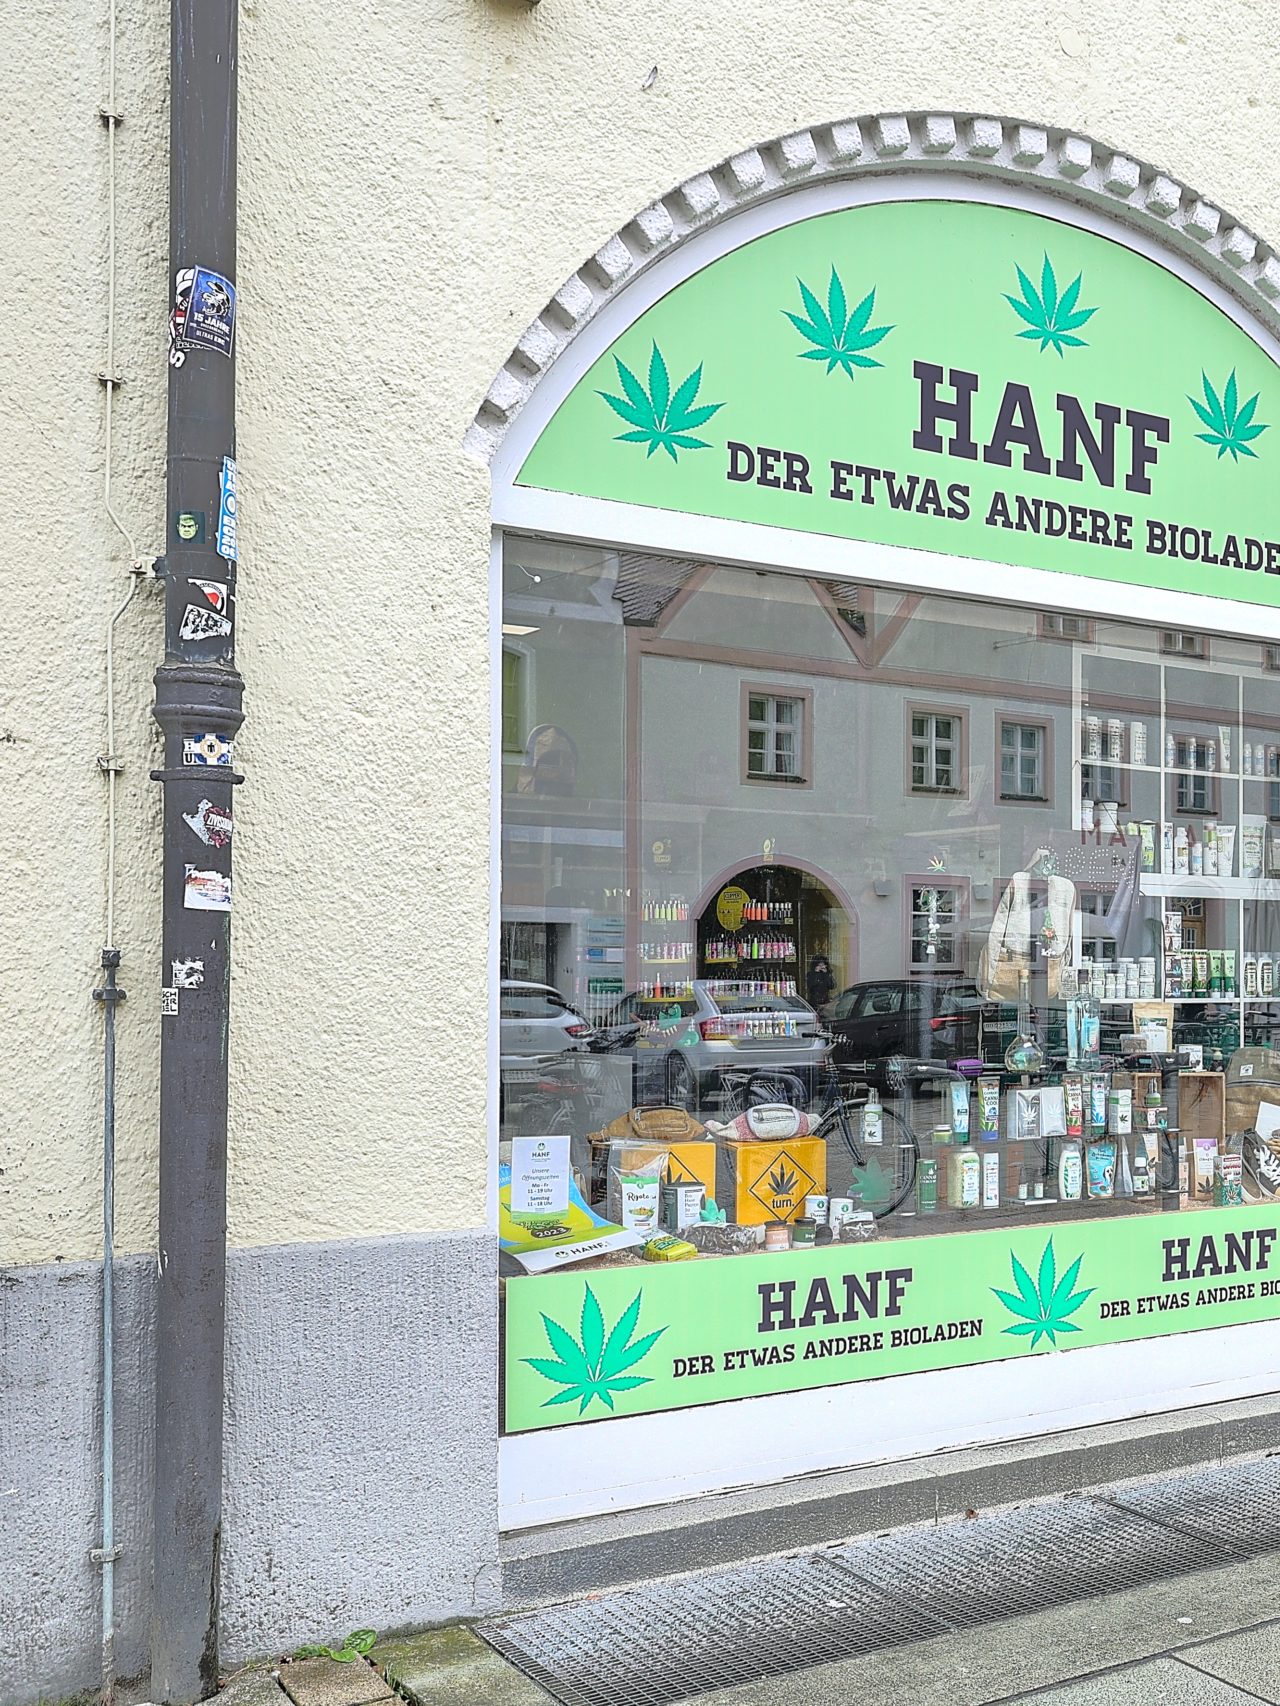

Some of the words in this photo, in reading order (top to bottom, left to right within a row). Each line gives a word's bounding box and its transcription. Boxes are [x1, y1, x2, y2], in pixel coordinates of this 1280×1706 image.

[193, 311, 204, 322] 15
[204, 316, 231, 335] JAHRE
[913, 361, 1169, 494] HANF
[728, 441, 812, 493] DER
[831, 460, 969, 520] ETWAS
[984, 488, 1132, 550] ANDERE
[772, 1198, 795, 1209] turn.
[535, 1227, 567, 1238] 2023
[1162, 1228, 1277, 1282] HANF
[757, 1269, 913, 1333] HANF
[1100, 1300, 1131, 1319] DER
[1136, 1291, 1190, 1314] ETWAS
[1196, 1283, 1255, 1306] ANDERE
[673, 1355, 715, 1378] DER
[724, 1344, 795, 1371] ETWAS
[804, 1332, 884, 1360] ANDERE
[890, 1319, 983, 1348] BIOLADEN
